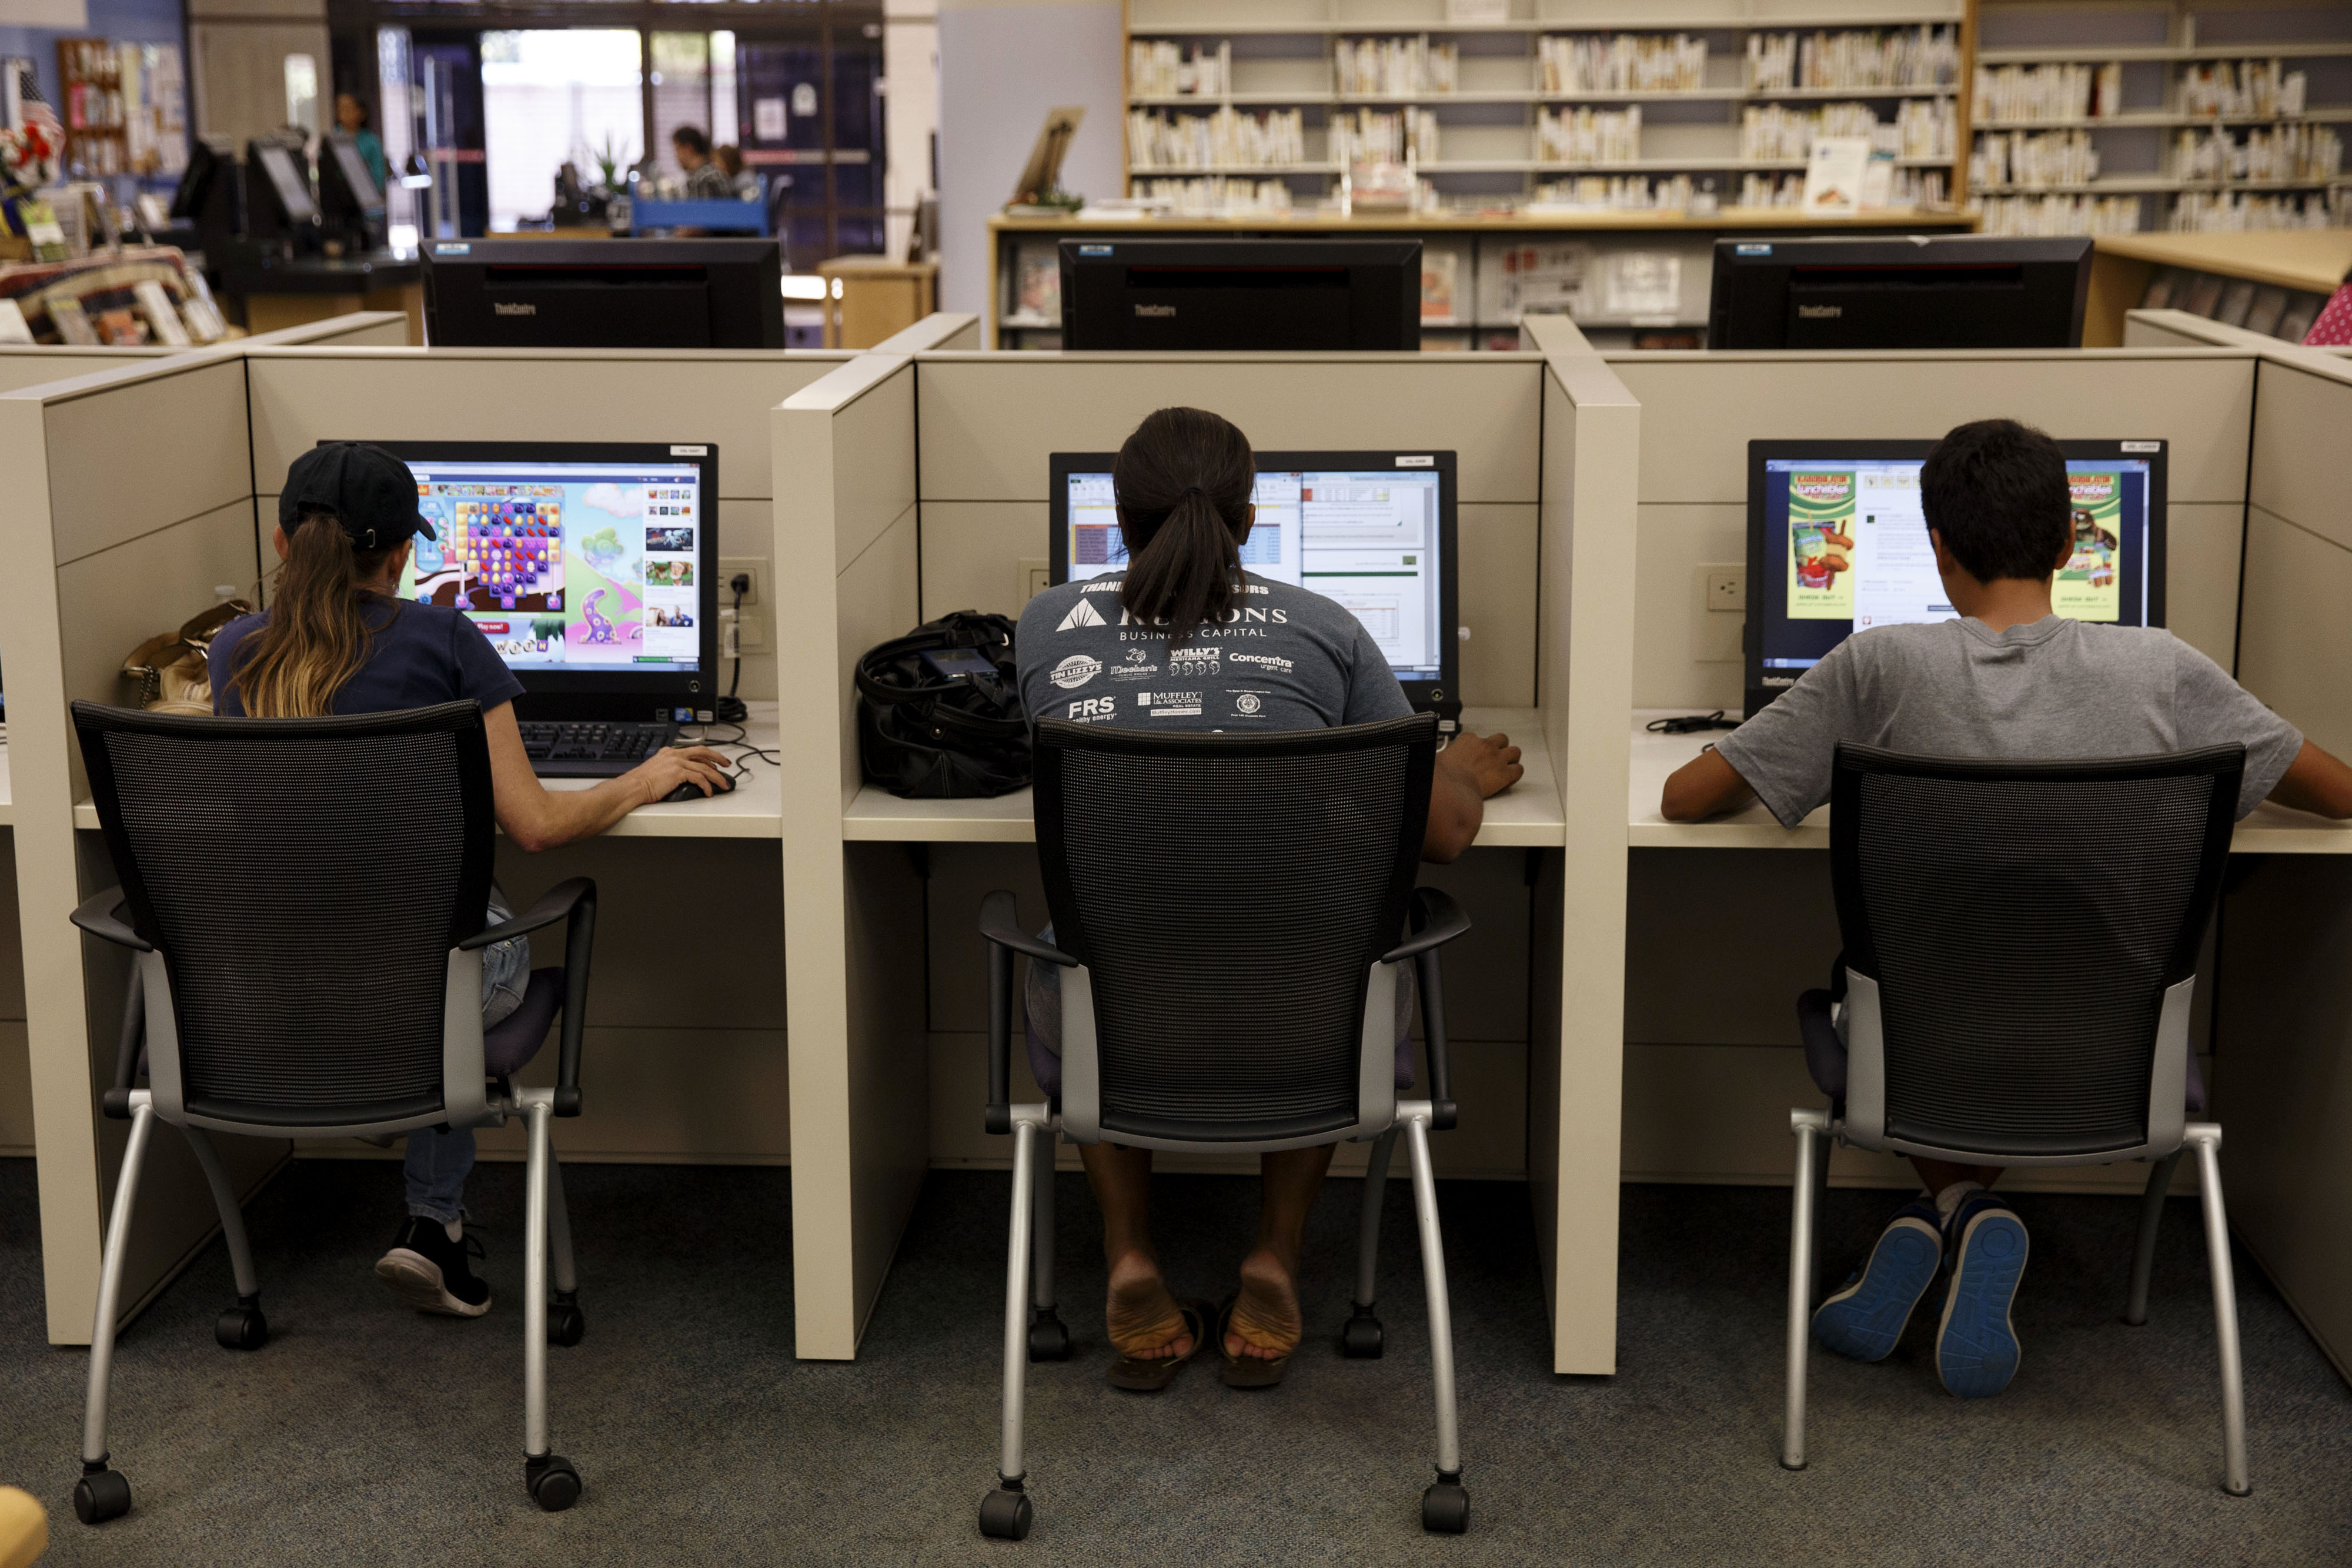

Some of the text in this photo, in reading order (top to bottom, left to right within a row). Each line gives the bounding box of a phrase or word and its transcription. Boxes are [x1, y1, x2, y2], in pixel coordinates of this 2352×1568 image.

[1080, 581, 1123, 593] THAN
[1201, 628, 1267, 638] CAPITAL
[1170, 647, 1220, 657] WILLY'S
[1229, 653, 1292, 668] Concentra
[1050, 664, 1102, 681] TIN LIZZY'S
[1068, 696, 1115, 718] FRS
